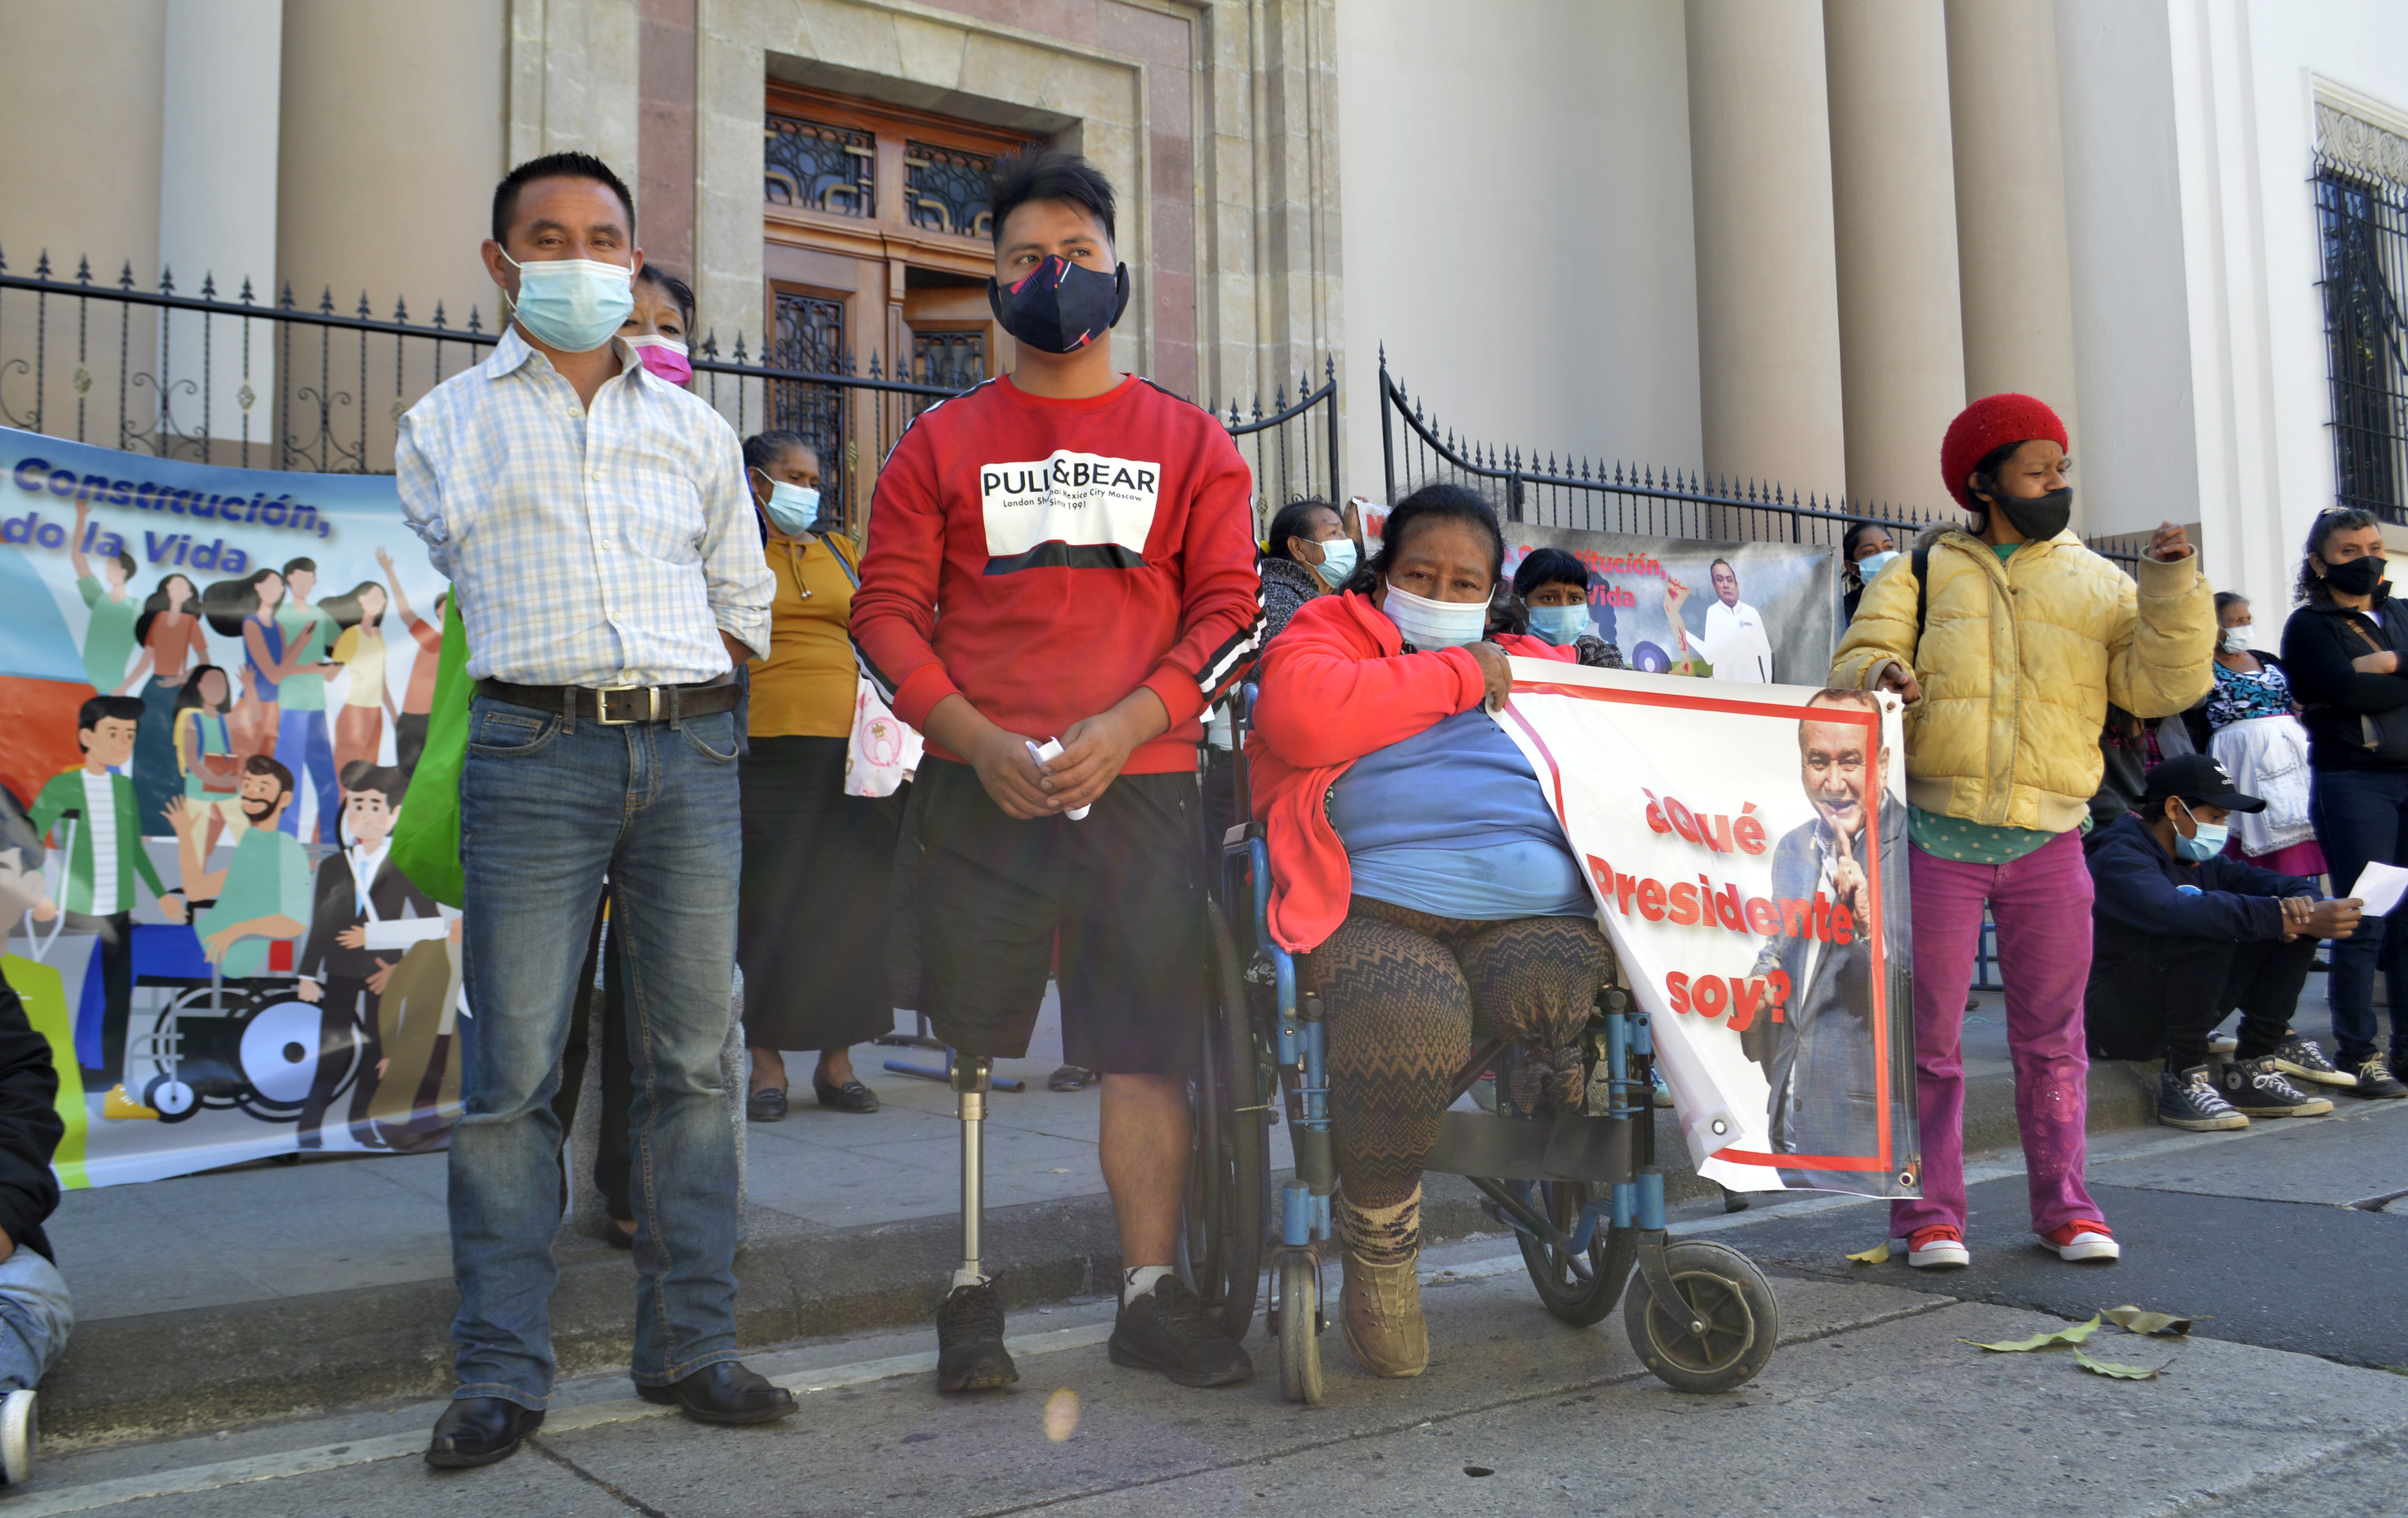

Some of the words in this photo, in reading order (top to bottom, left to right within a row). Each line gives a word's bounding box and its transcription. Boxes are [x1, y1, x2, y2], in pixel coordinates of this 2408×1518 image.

[14, 458, 330, 538] Constitución,
[983, 459, 1154, 496] PULL&BEAR
[1003, 498, 1034, 507] London
[1063, 489, 1087, 499] Mexico
[1089, 488, 1105, 497] City
[1108, 490, 1142, 501] Moscow
[1068, 501, 1086, 510] 1991
[79, 521, 124, 558] la
[145, 530, 248, 574] Vida
[1587, 584, 1635, 607] Vida
[1641, 786, 1767, 855] ¿Qué
[1586, 853, 1853, 945] Presidente
[1666, 969, 1791, 1032] soy?
